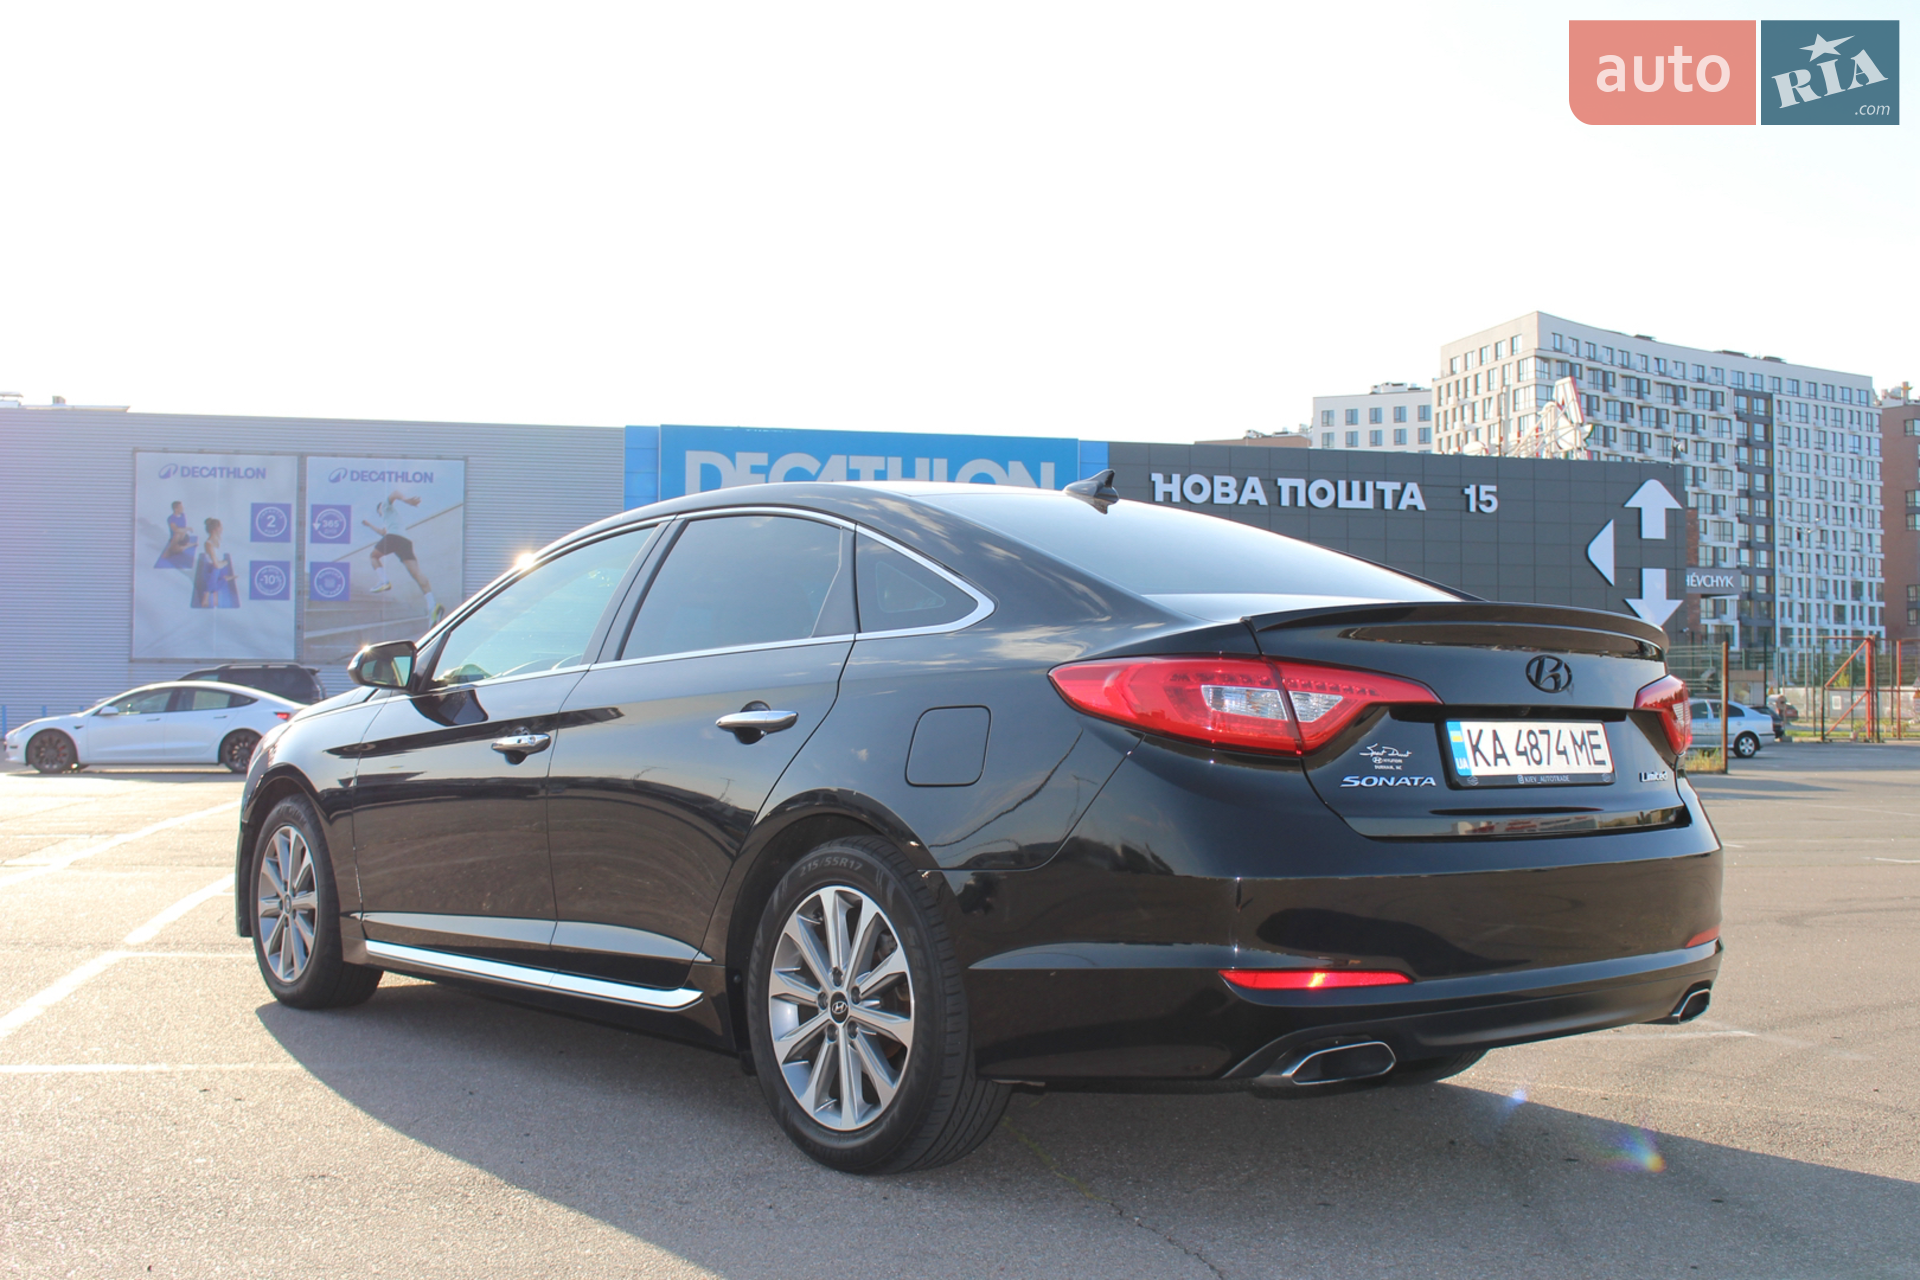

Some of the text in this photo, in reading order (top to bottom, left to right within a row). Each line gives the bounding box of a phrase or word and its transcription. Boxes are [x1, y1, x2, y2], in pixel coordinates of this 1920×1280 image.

[180, 466, 267, 480] DECATHLON
[349, 470, 434, 484] DECATHLON
[1150, 472, 1498, 513] НОВА ПОШТА 15
[266, 514, 277, 528] 2
[322, 519, 340, 528] 365
[259, 574, 283, 585] -10%
[1467, 729, 1607, 767] KA 4874 ME
[1455, 757, 1470, 770] UA
[1340, 775, 1437, 788] SONATA
[799, 856, 863, 878] 215/55R17
